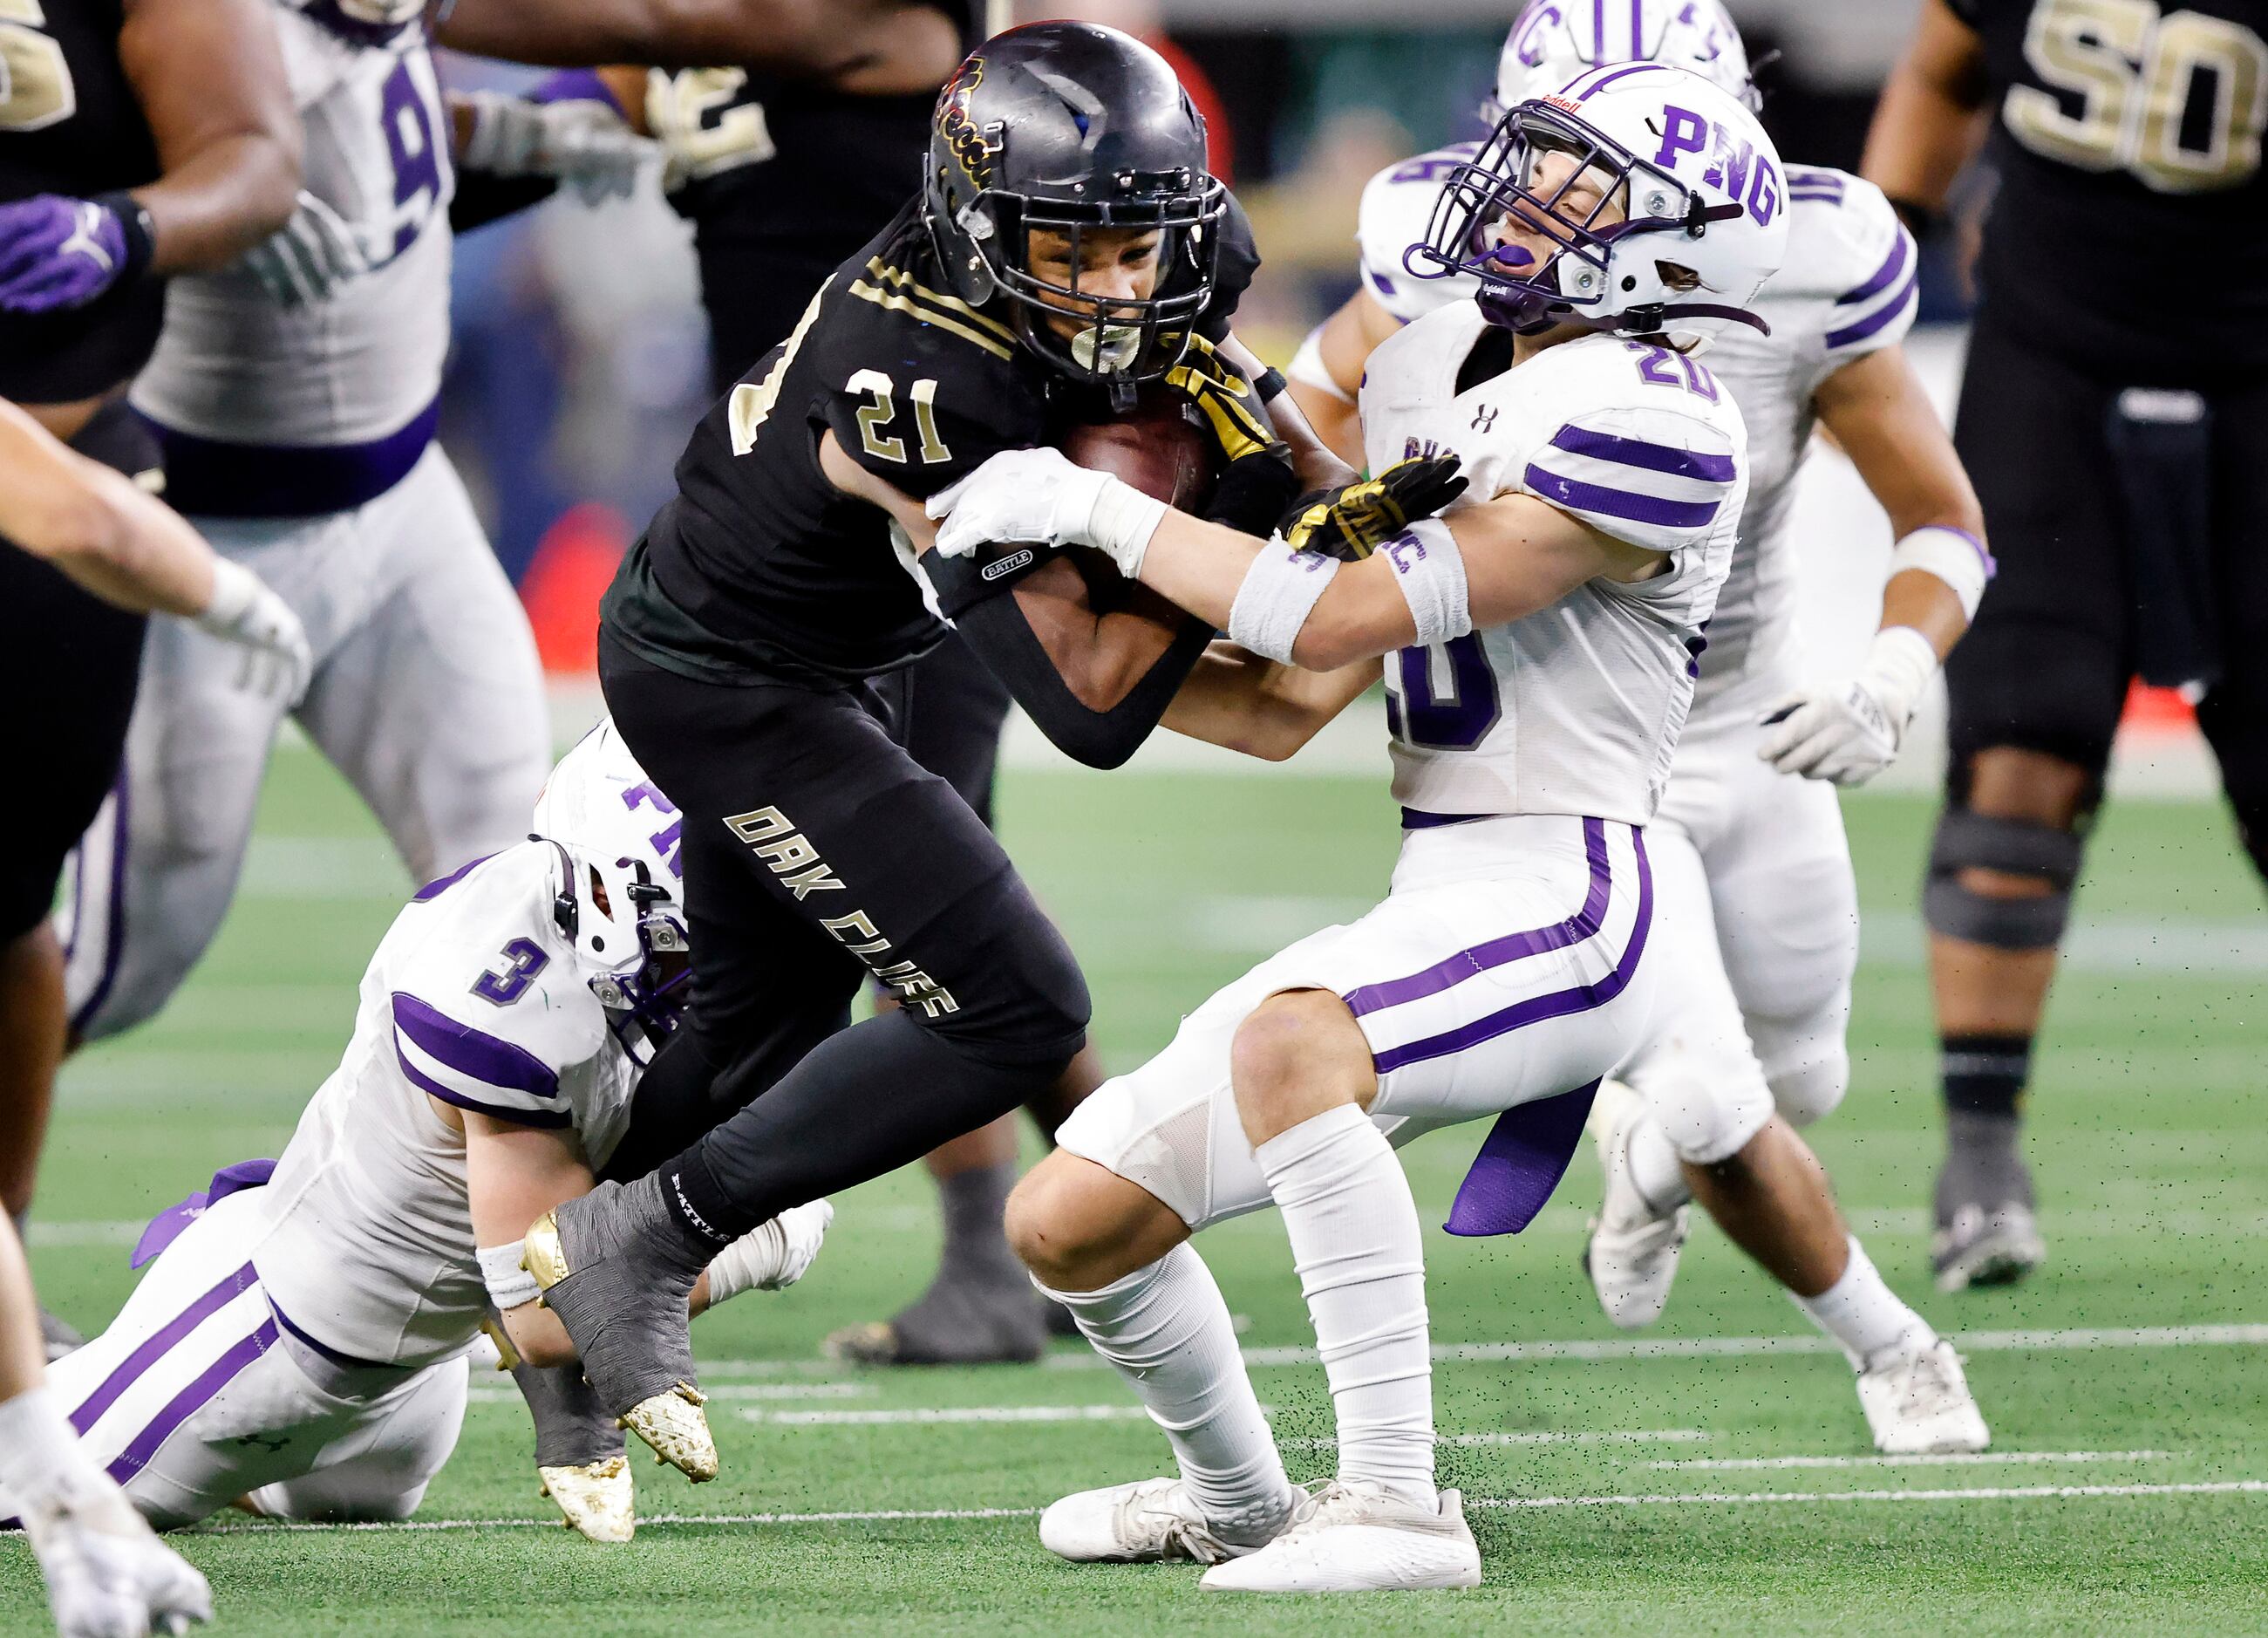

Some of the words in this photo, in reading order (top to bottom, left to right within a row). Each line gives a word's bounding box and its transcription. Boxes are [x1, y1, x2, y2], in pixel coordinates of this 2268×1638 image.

[2003, 0, 2268, 195] 50
[1654, 104, 1778, 227] PNG
[844, 368, 952, 464] 21
[1623, 340, 1721, 407] 20
[986, 552, 1029, 577] BATTLE
[1385, 629, 1502, 752] 0
[722, 805, 847, 902] OAK
[819, 909, 961, 1018] CLIFF
[468, 936, 551, 1008] 3
